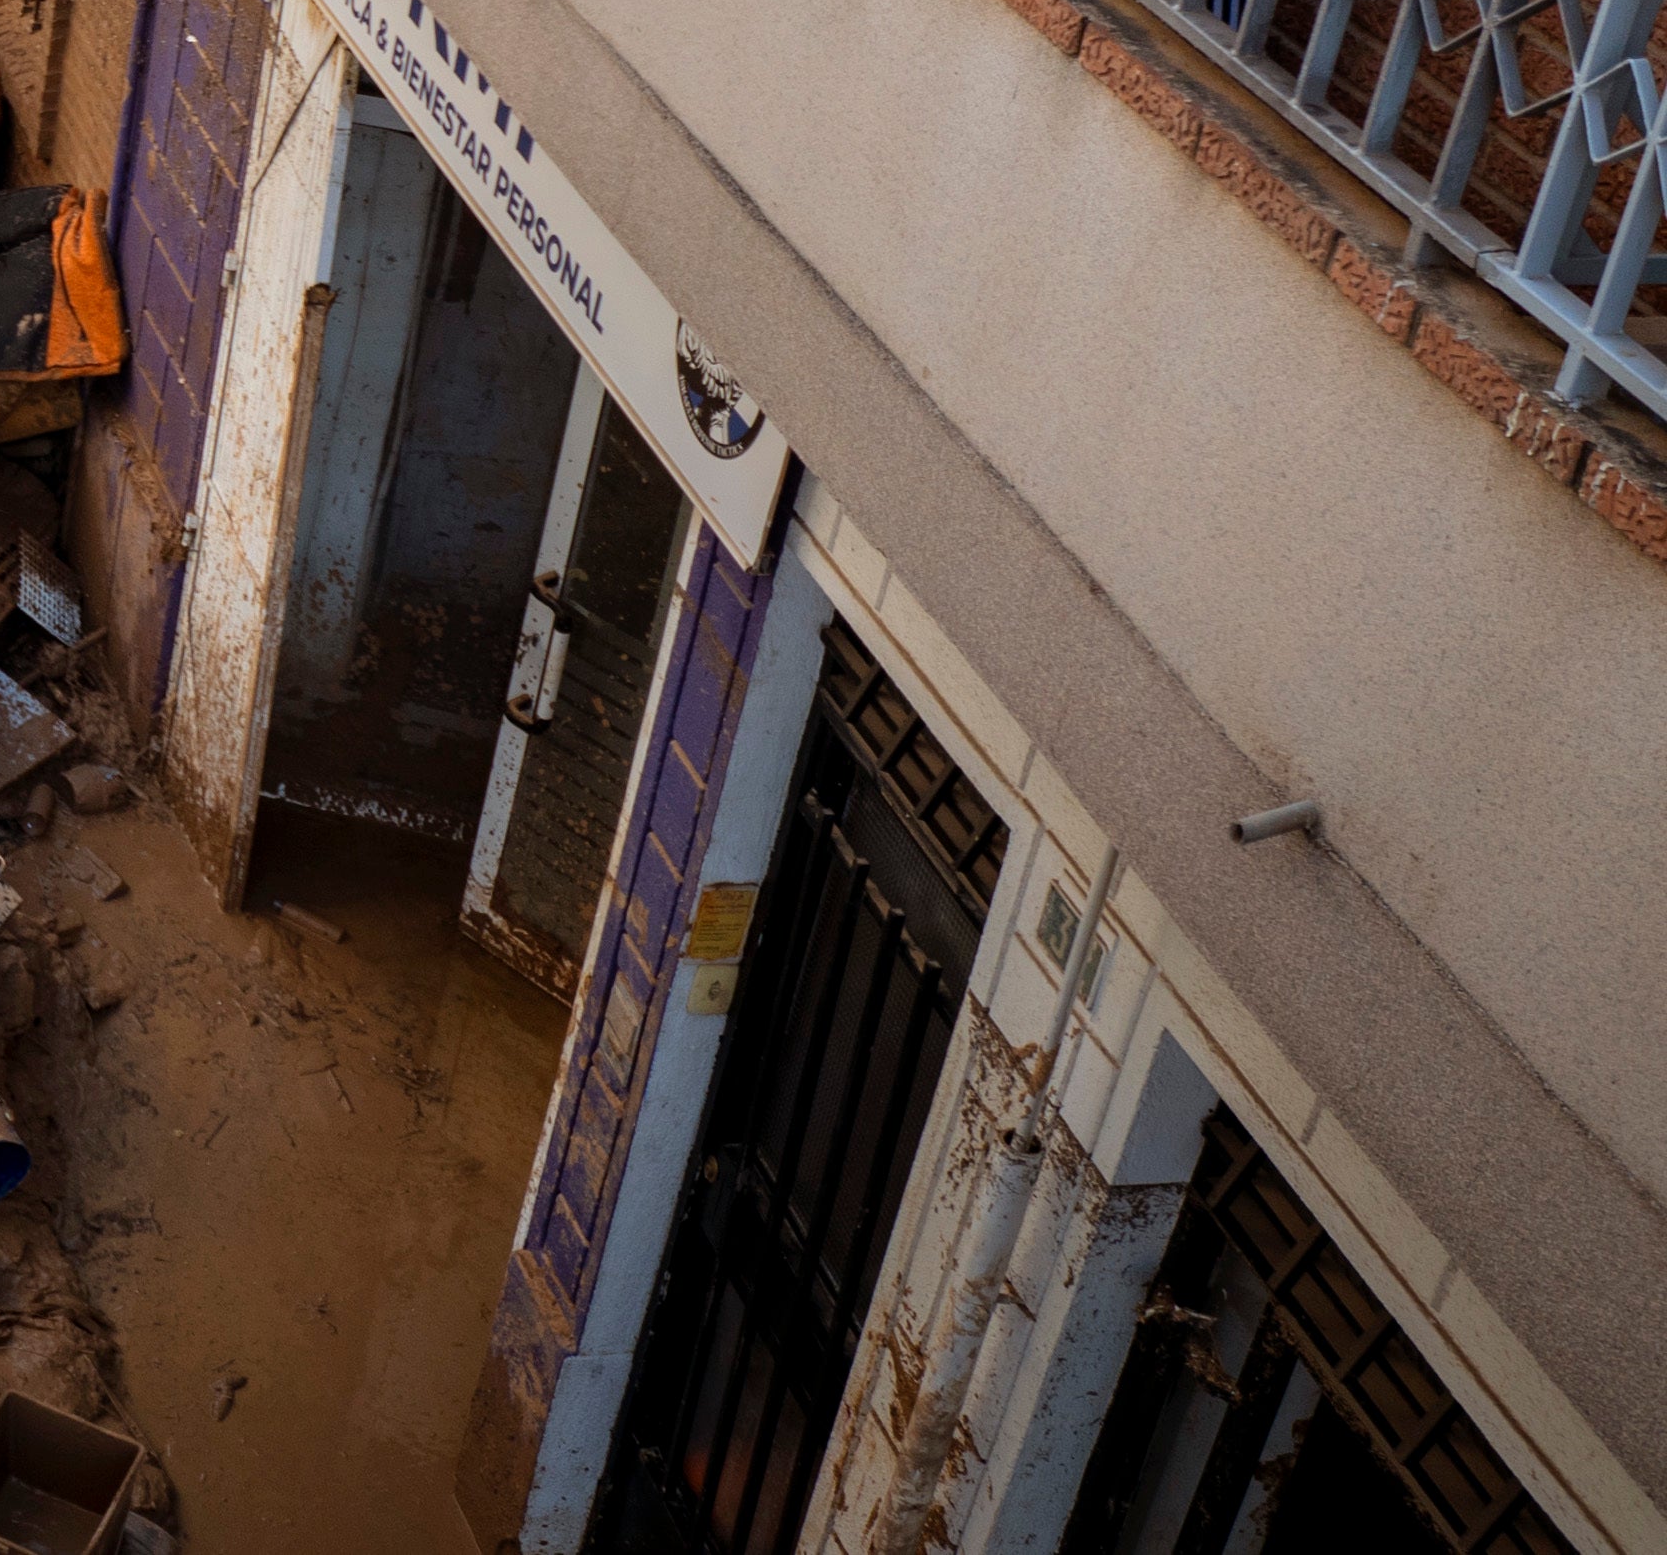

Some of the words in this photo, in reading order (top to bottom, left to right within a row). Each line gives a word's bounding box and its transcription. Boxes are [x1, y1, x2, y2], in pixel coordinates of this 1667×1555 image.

[376, 18, 389, 53] &
[391, 35, 492, 184] BIENESTAR
[493, 165, 604, 335] PERSONAL
